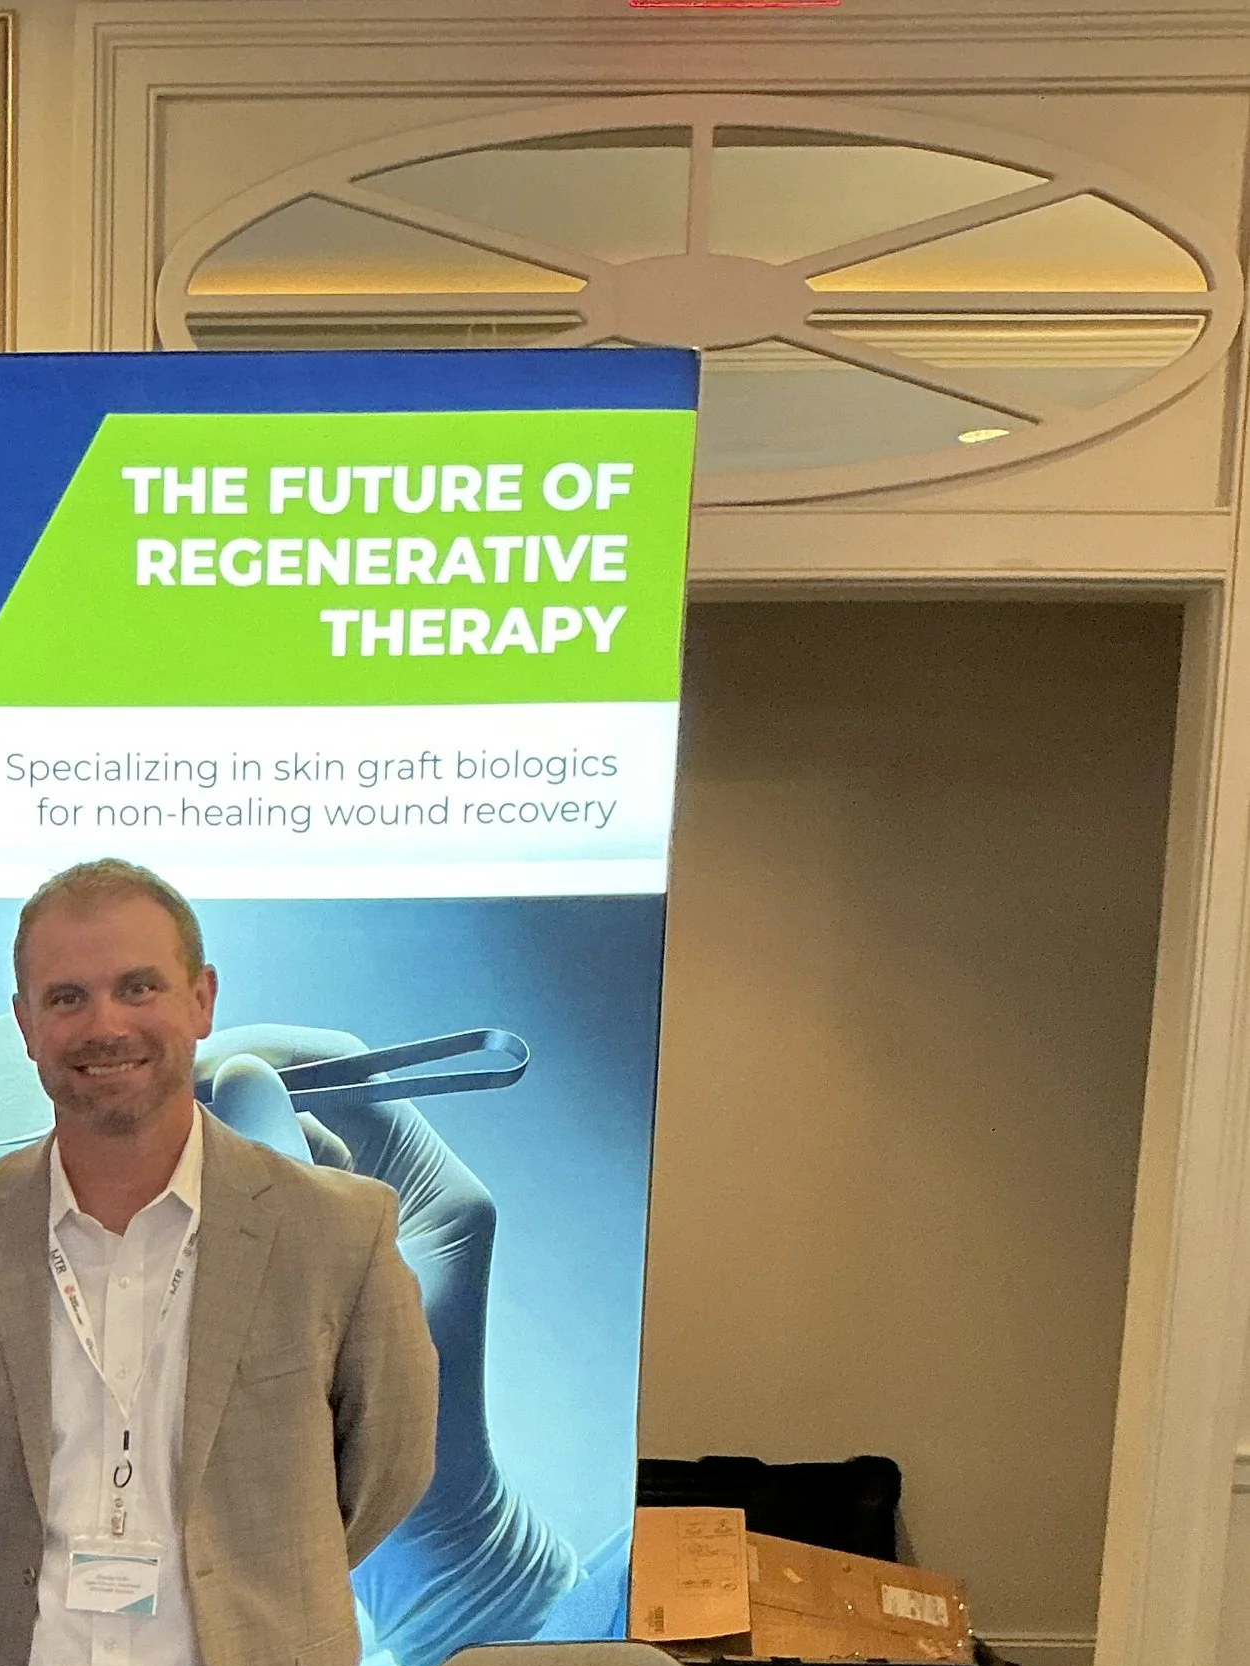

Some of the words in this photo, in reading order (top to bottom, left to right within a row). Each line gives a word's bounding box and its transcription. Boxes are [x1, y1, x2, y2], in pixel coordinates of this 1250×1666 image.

[121, 466, 248, 515] THE
[269, 464, 524, 515] FUTURE
[542, 462, 634, 511] OF
[135, 534, 628, 587] REGENERATIVE
[320, 606, 628, 657] THERAPY
[6, 752, 217, 788] Specializing
[232, 751, 261, 781] in
[274, 751, 344, 781] skin
[358, 750, 443, 788] graft
[457, 747, 617, 785] biologics
[37, 797, 84, 826] for
[97, 797, 311, 833] non-healing
[324, 796, 449, 826] wound
[463, 800, 617, 829] recovery
